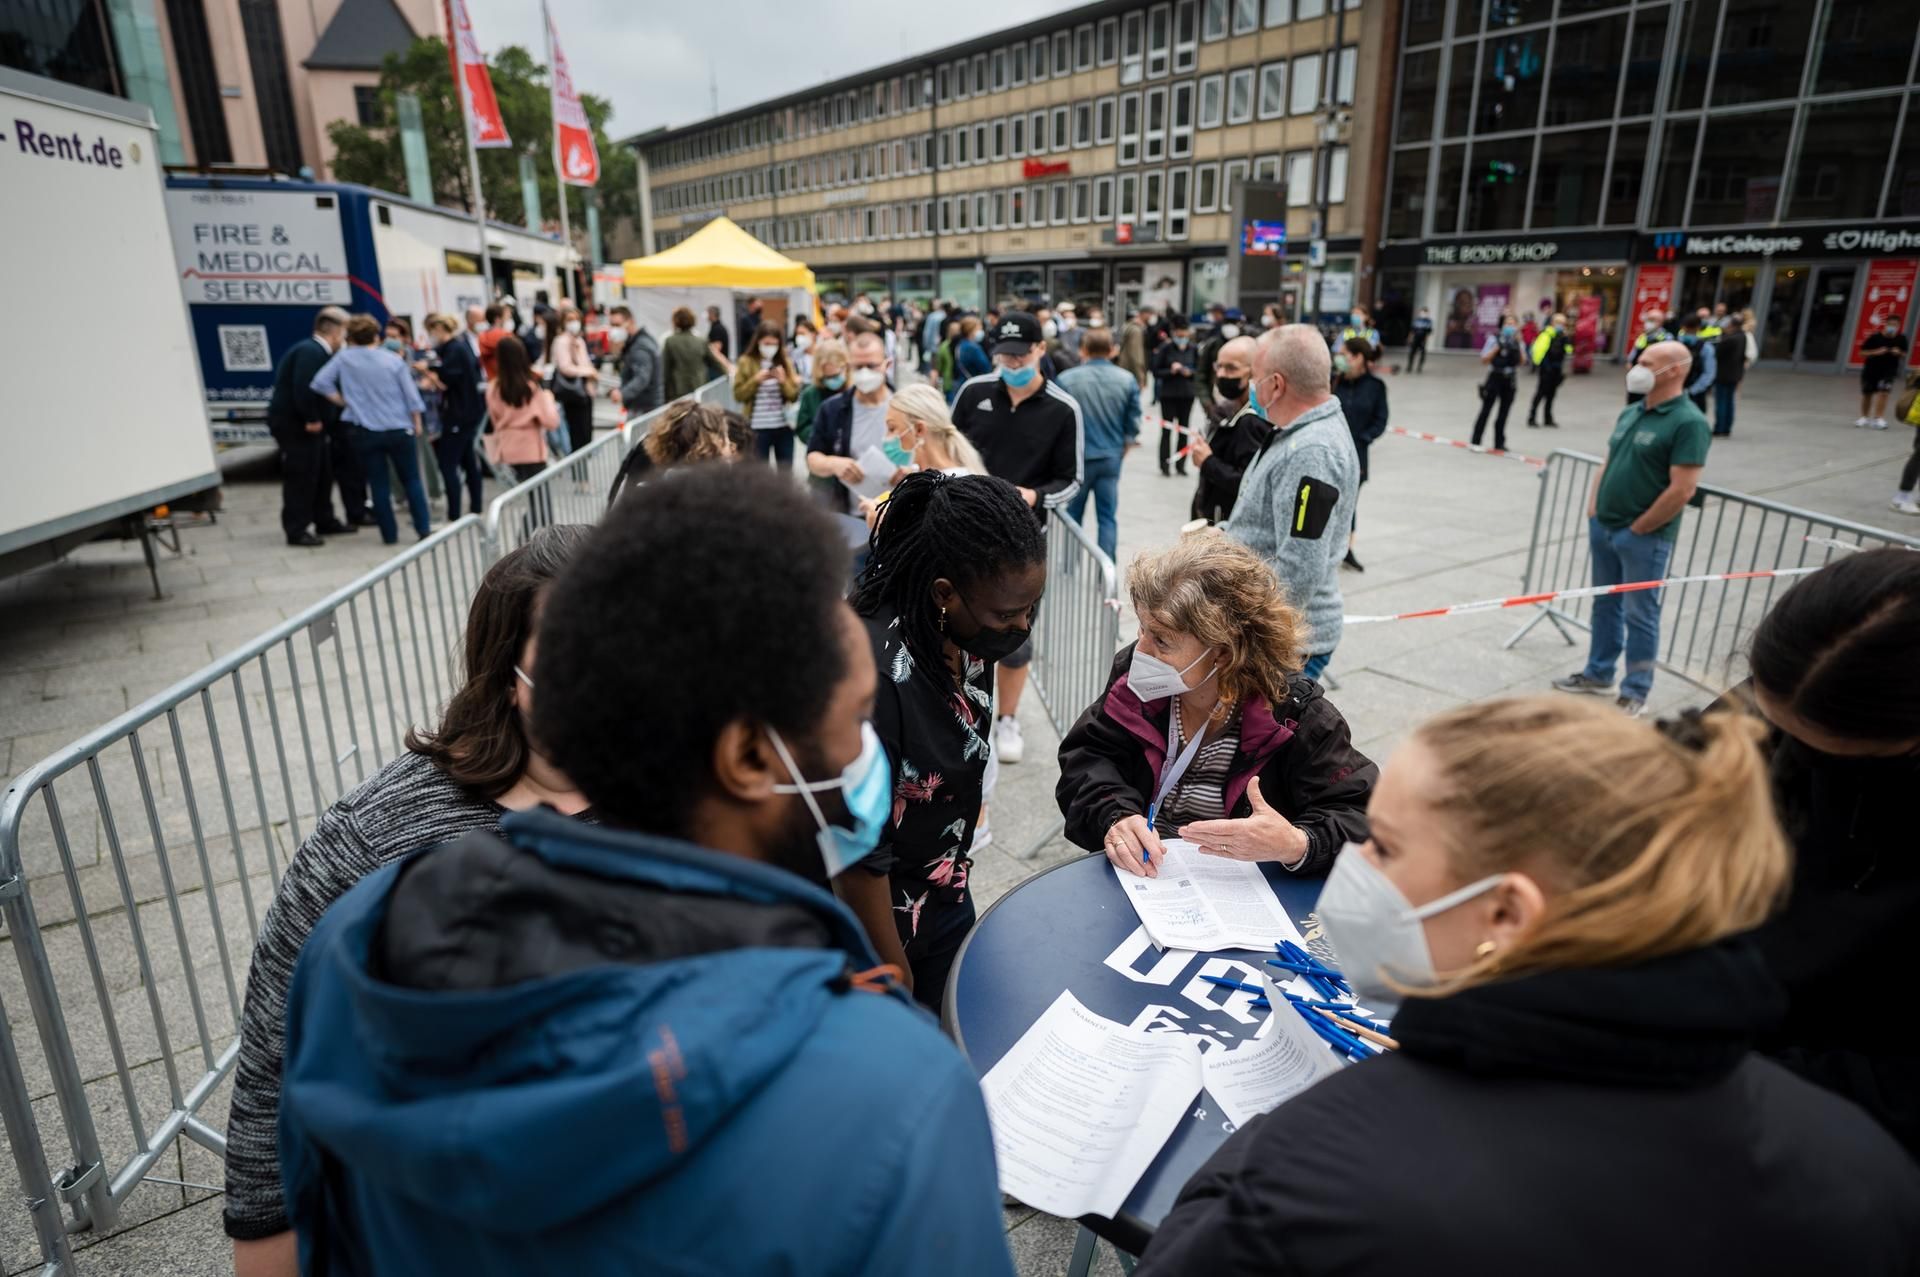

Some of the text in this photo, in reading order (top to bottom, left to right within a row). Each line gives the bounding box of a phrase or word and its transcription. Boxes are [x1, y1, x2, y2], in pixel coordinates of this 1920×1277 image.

[14, 119, 122, 168] Rent.de
[194, 225, 290, 245] FIRE &
[1426, 243, 1558, 262] THE BODY SHOP
[1687, 236, 1802, 255] NetCologne
[199, 252, 330, 273] MEDICAL
[203, 280, 332, 301] SERVICE
